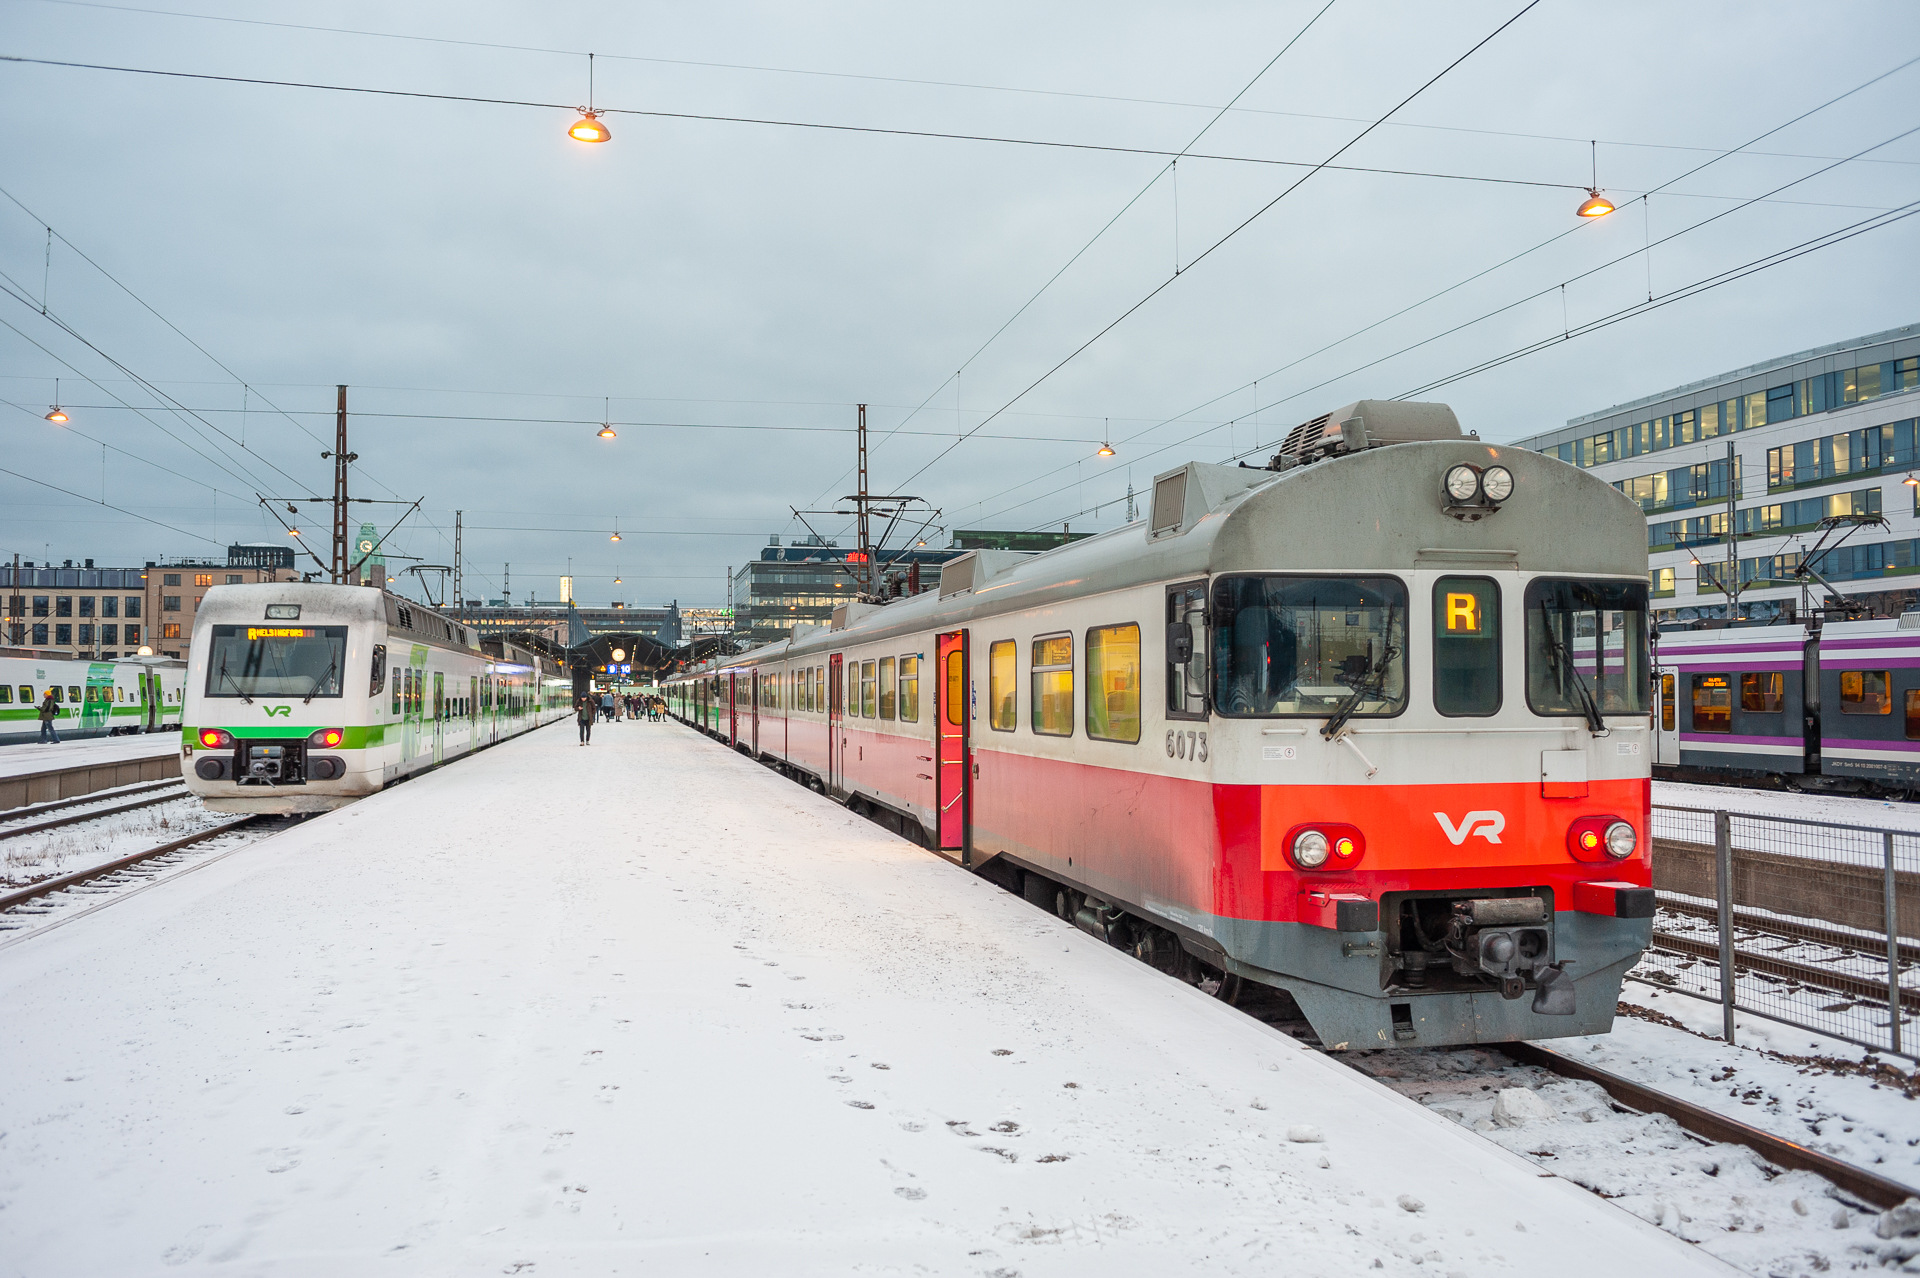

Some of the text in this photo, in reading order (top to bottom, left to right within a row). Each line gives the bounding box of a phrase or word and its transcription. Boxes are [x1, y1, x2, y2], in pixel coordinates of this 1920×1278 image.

[1447, 593, 1476, 630] R
[248, 628, 303, 640] R HELSINGFORS
[262, 705, 291, 717] VR
[1166, 729, 1208, 763] 6073
[1433, 810, 1505, 845] VR
